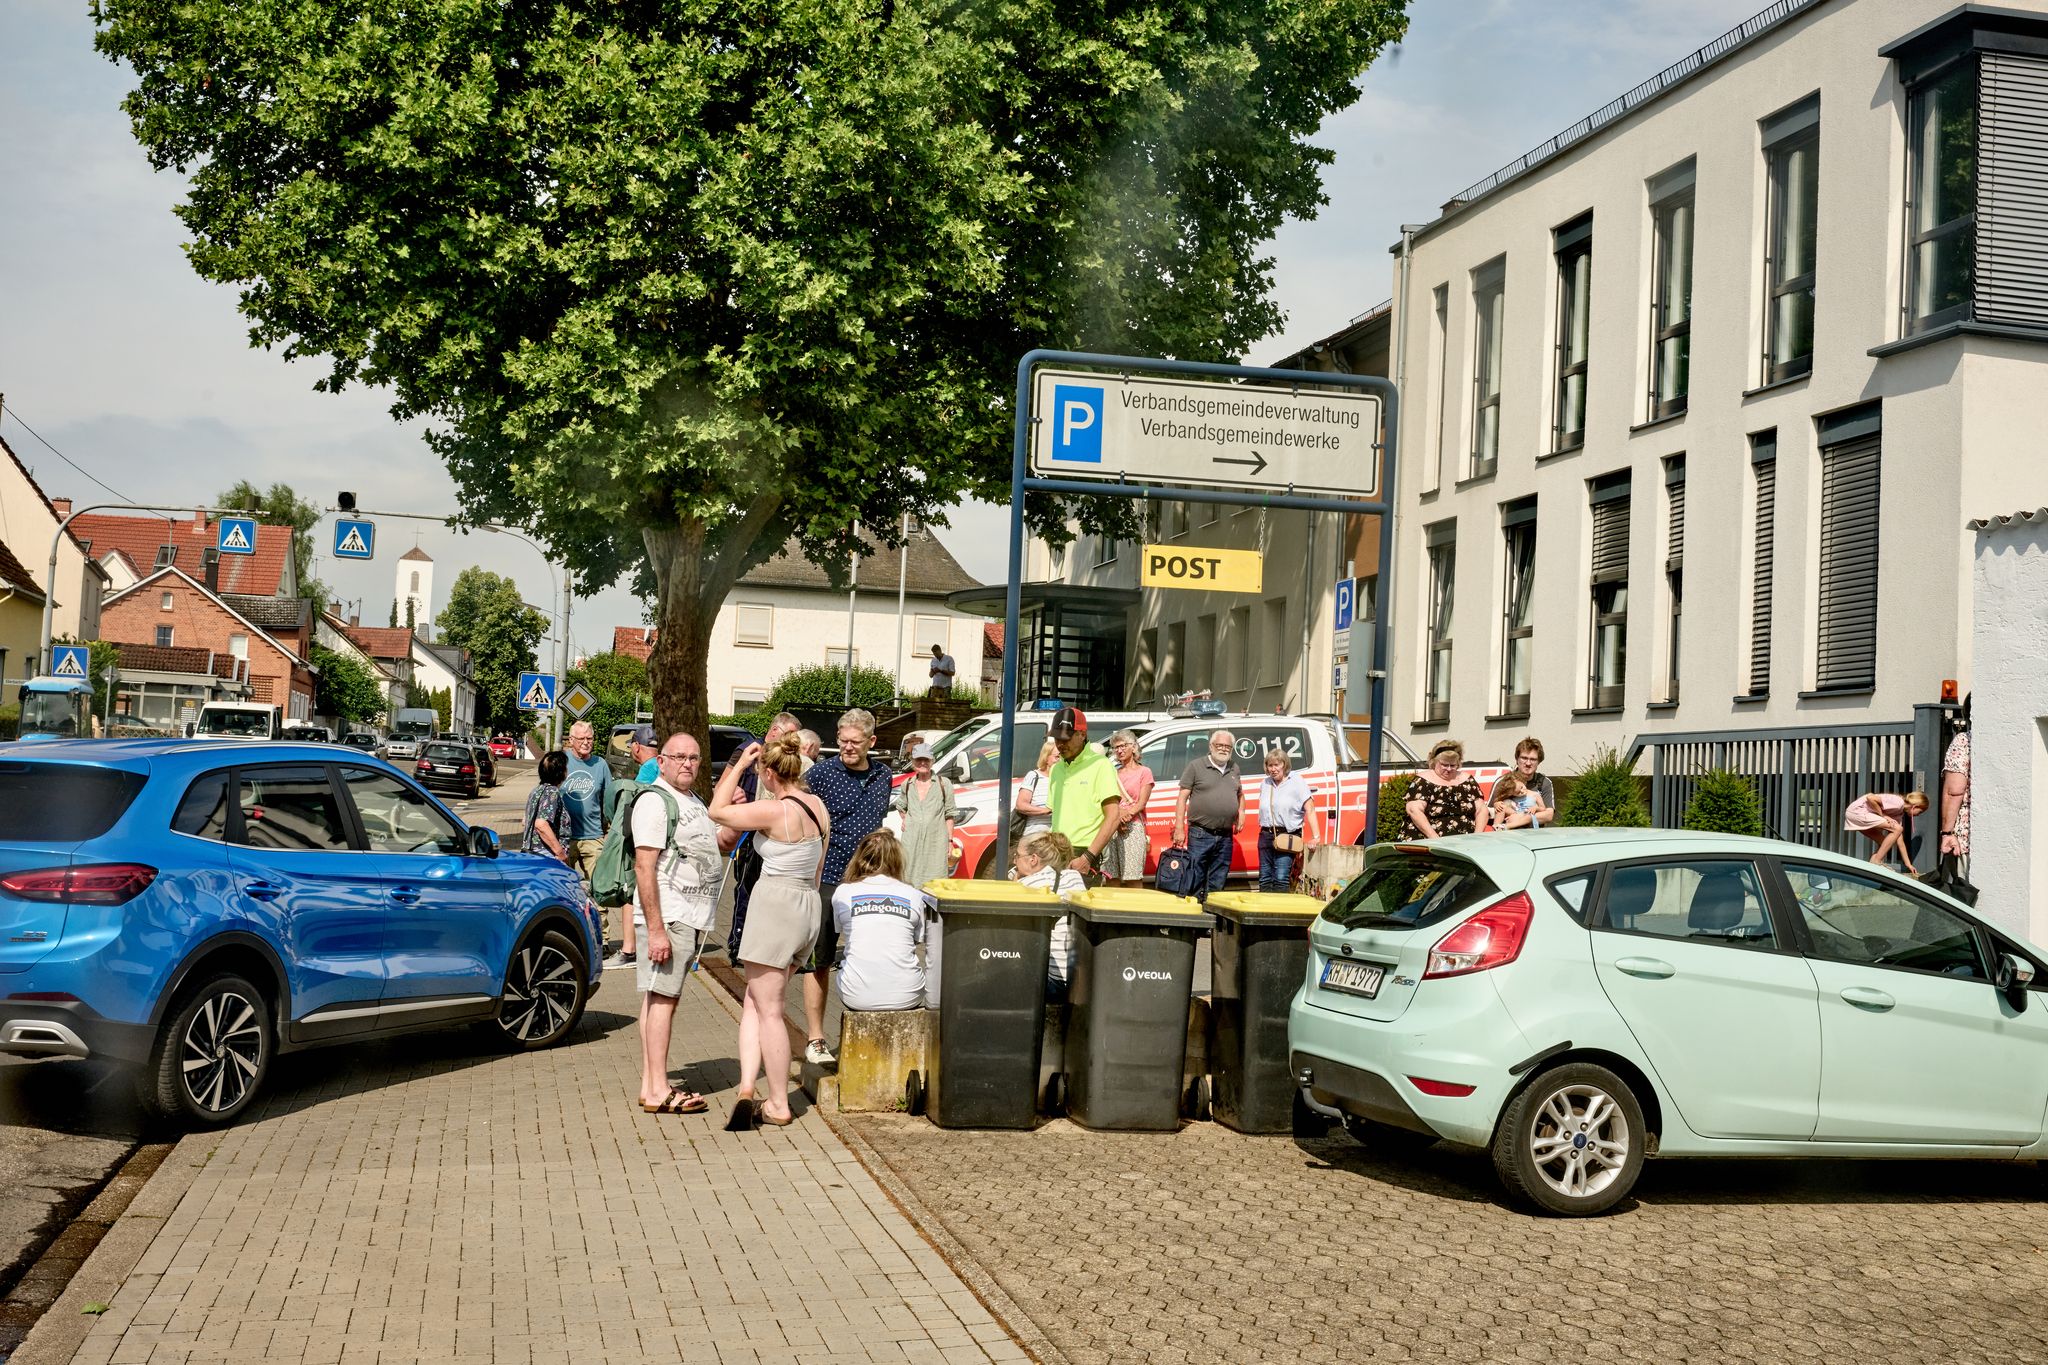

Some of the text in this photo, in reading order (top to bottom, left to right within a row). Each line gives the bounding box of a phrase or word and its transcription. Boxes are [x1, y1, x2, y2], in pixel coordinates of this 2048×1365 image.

[1121, 390, 1360, 429] Verbandsgemeindeverwaltung
[1062, 400, 1095, 446] P
[1141, 417, 1340, 450] Verbandsgemeindewerke
[1149, 555, 1221, 580] POST
[1338, 586, 1349, 625] P
[1256, 736, 1302, 758] 112
[854, 904, 909, 916] patagonia
[991, 951, 1021, 959] VEOLIA
[1137, 971, 1172, 980] VEOLIA
[1350, 967, 1381, 990] 1977
